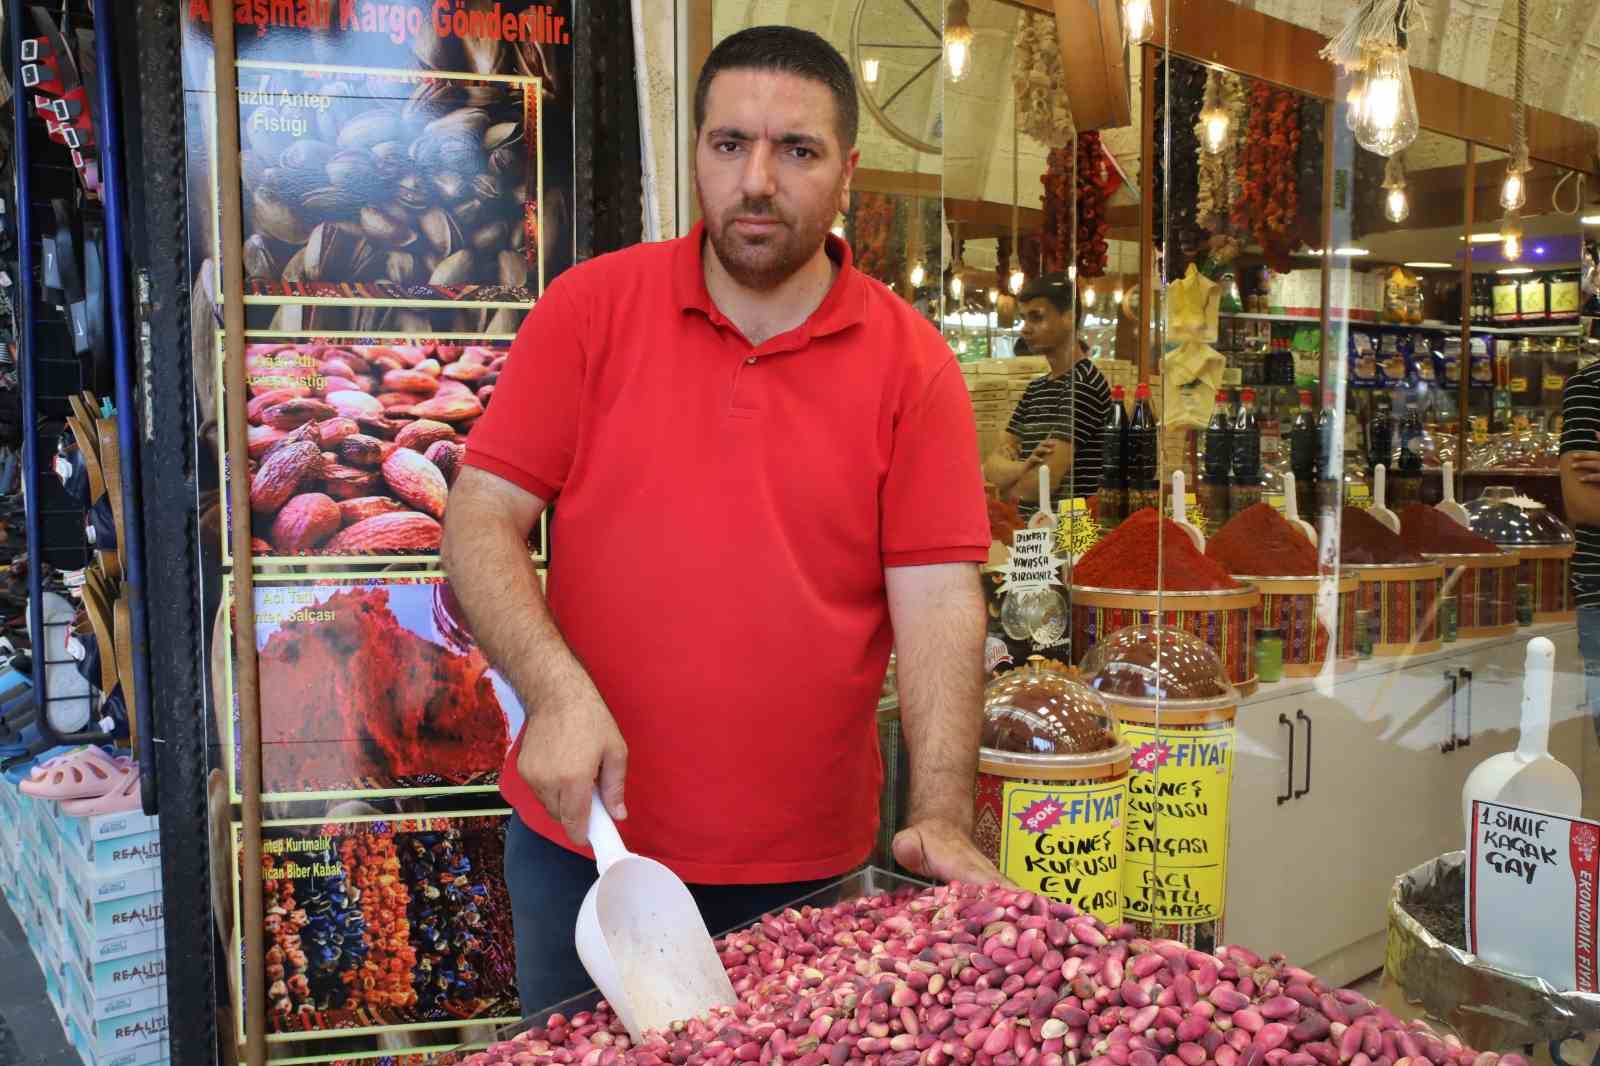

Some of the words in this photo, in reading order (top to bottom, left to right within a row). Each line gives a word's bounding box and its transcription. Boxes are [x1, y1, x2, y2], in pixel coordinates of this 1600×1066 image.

[188, 0, 331, 37] Aaşmalı
[339, 0, 422, 44] Kargo
[431, 0, 571, 45] Gönderilir.
[239, 86, 275, 107] uzlu
[279, 88, 331, 113] Antep
[1175, 737, 1229, 767] FİYAT
[1070, 790, 1123, 825] FİYAT
[263, 838, 284, 856] ntep
[286, 863, 311, 879] Biber
[312, 861, 342, 878] Kabak
[1024, 854, 1118, 876] KURUSU
[1039, 875, 1083, 895] EV
